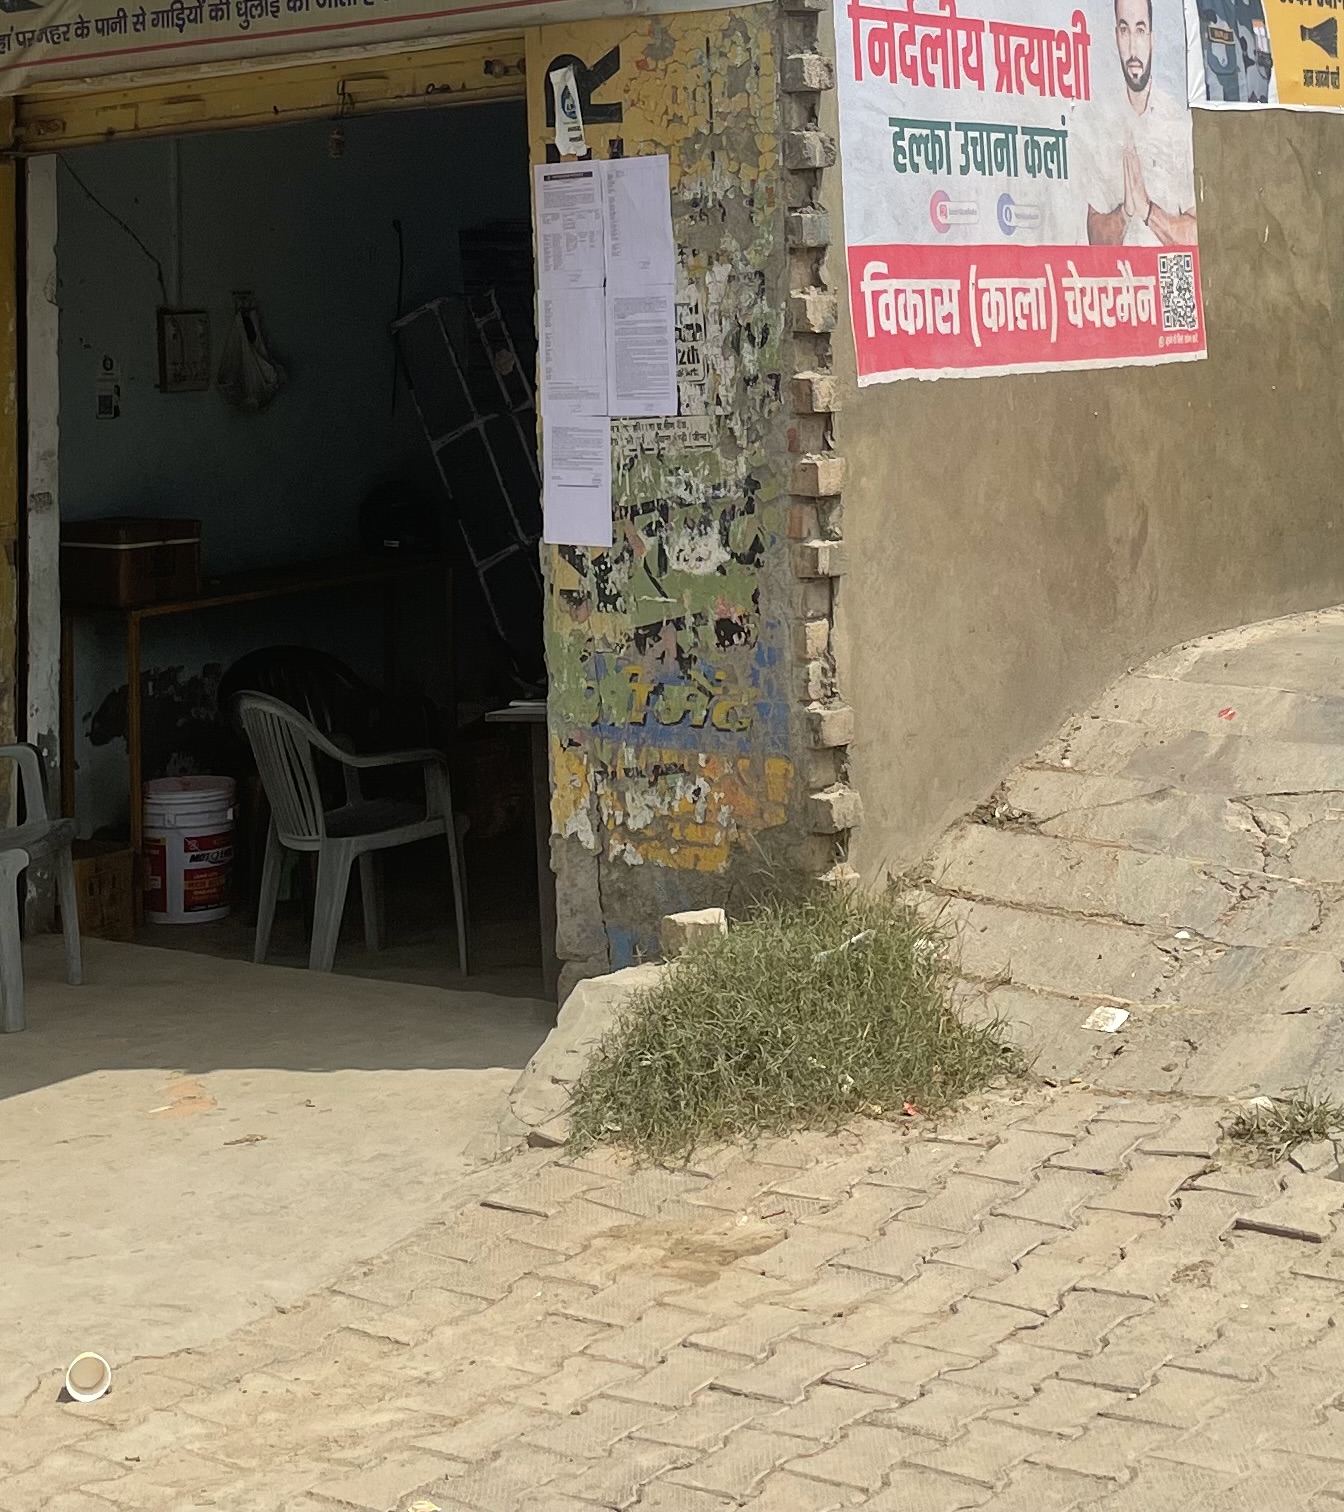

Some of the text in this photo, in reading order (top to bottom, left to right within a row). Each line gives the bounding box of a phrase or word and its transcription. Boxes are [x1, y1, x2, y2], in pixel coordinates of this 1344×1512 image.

[15, 29, 36, 49] पर
[37, 23, 71, 45] नहर
[74, 14, 91, 40] के
[95, 7, 127, 36] पानी
[132, 6, 146, 33] से
[989, 9, 1091, 101] प्रत्याशी
[888, 114, 1068, 179] हल्का उचाना कलां
[860, 259, 1157, 347] विकास (काला) चेयरमैन
